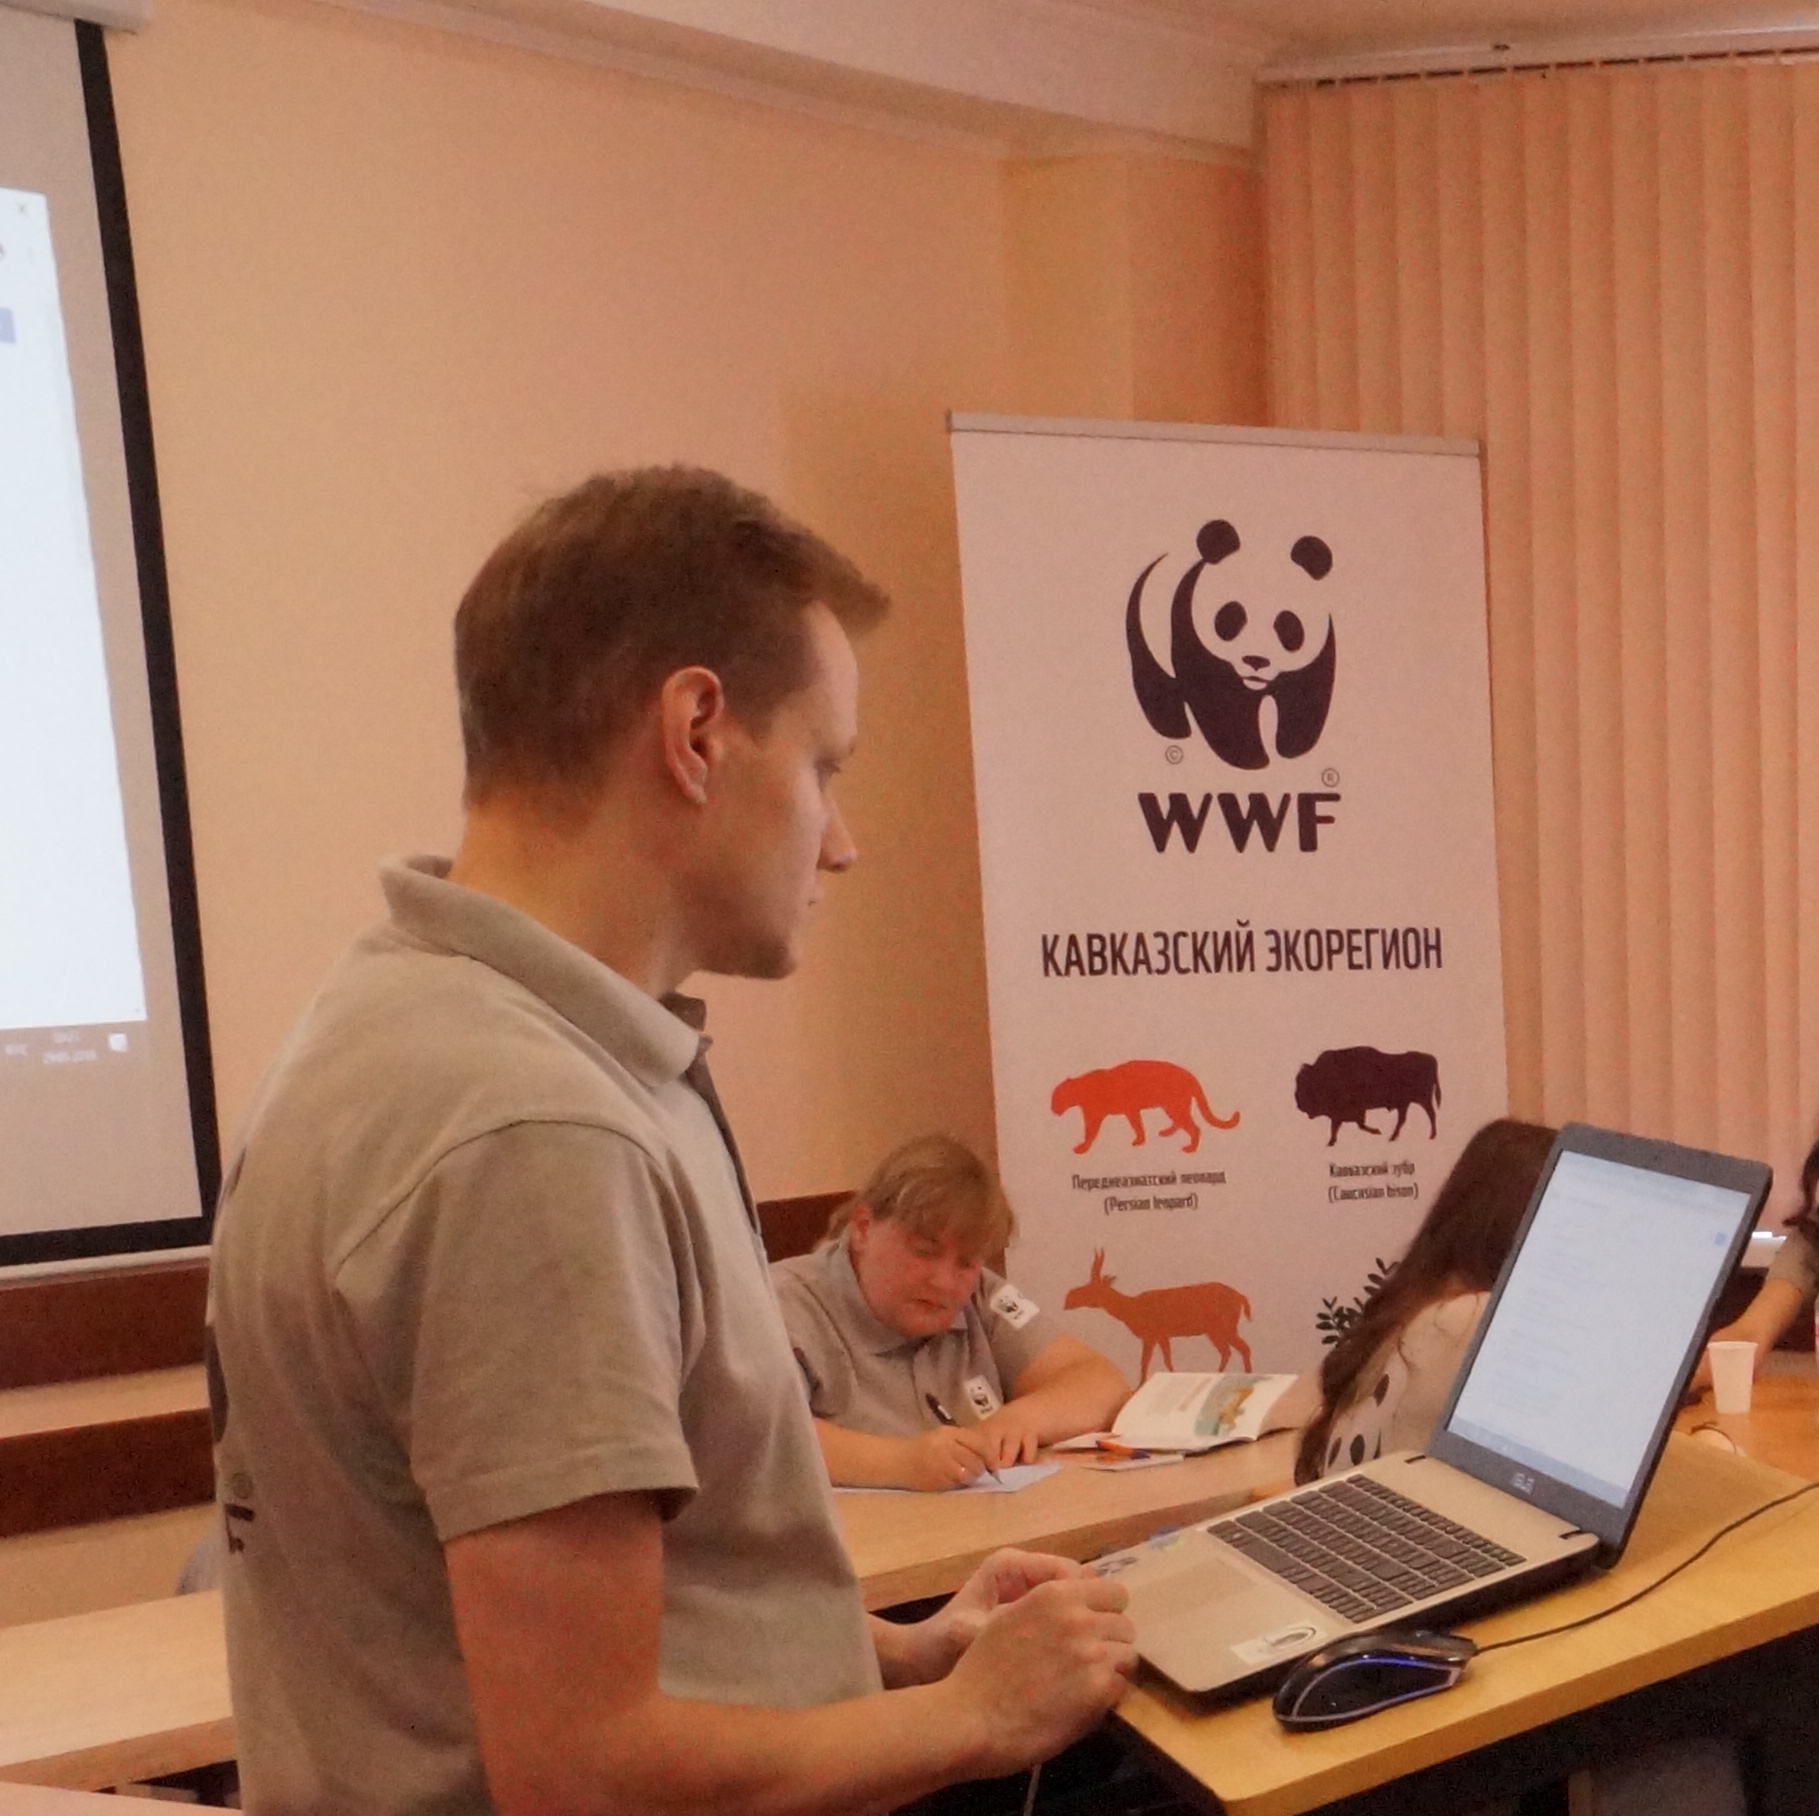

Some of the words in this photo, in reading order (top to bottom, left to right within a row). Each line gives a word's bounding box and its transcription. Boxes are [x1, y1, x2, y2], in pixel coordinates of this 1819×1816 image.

[1138, 792, 1341, 853] WWF
[1041, 918, 1256, 977] КАВКАЗСКИЙ
[1264, 926, 1443, 973] ЭКОРЕГИОН
